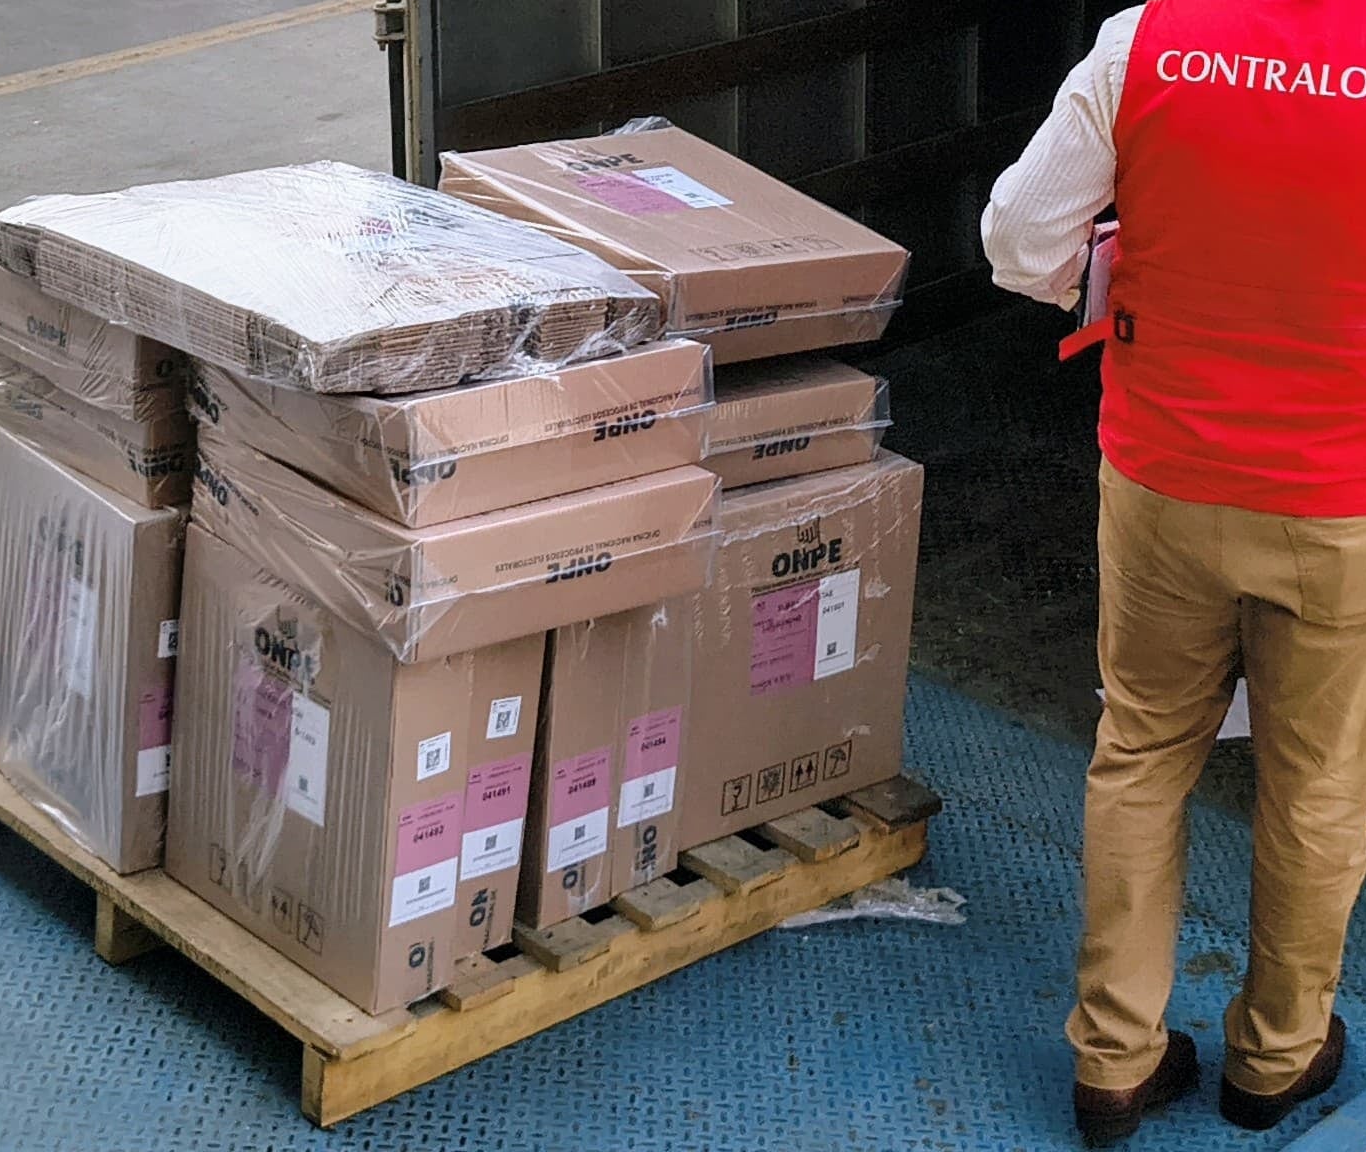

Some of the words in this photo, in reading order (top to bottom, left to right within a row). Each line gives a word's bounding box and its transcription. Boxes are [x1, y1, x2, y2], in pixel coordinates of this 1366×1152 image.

[592, 409, 657, 443] ONPE
[752, 436, 811, 461] ONPE
[544, 551, 613, 585] ONPE
[771, 538, 843, 578] ONPE
